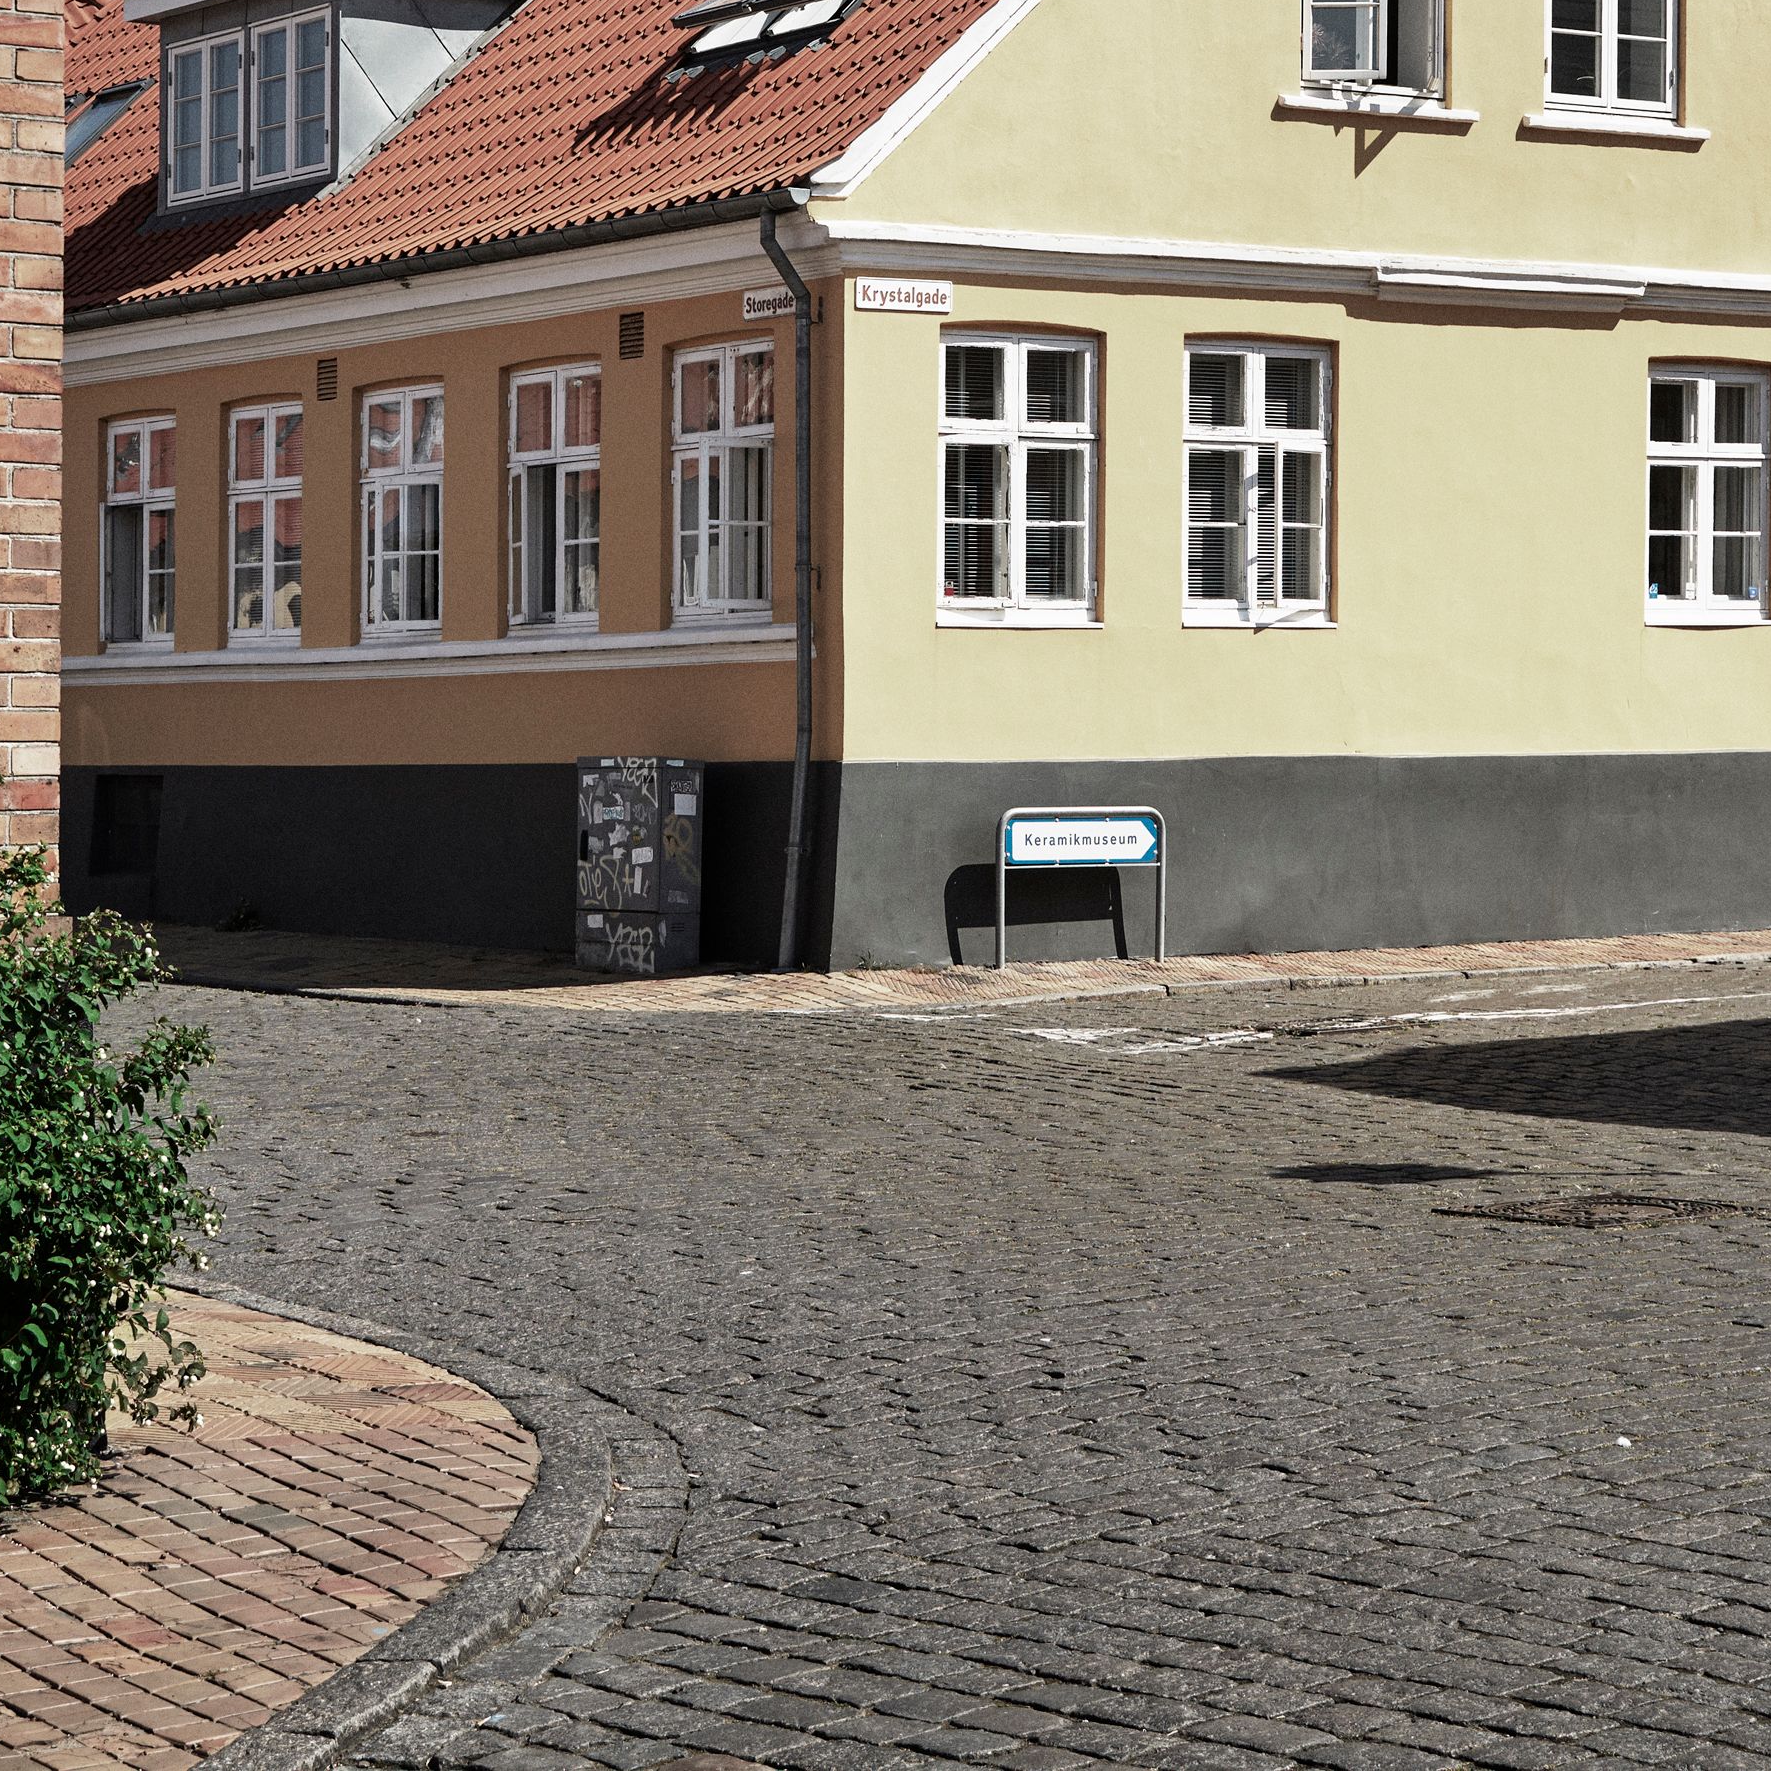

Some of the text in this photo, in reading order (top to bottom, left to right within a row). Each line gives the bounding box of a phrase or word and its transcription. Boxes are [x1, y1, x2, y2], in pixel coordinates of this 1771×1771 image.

[745, 291, 795, 315] Storegade
[861, 284, 948, 308] Krystalgade
[1024, 833, 1138, 847] Keramikmuseum
